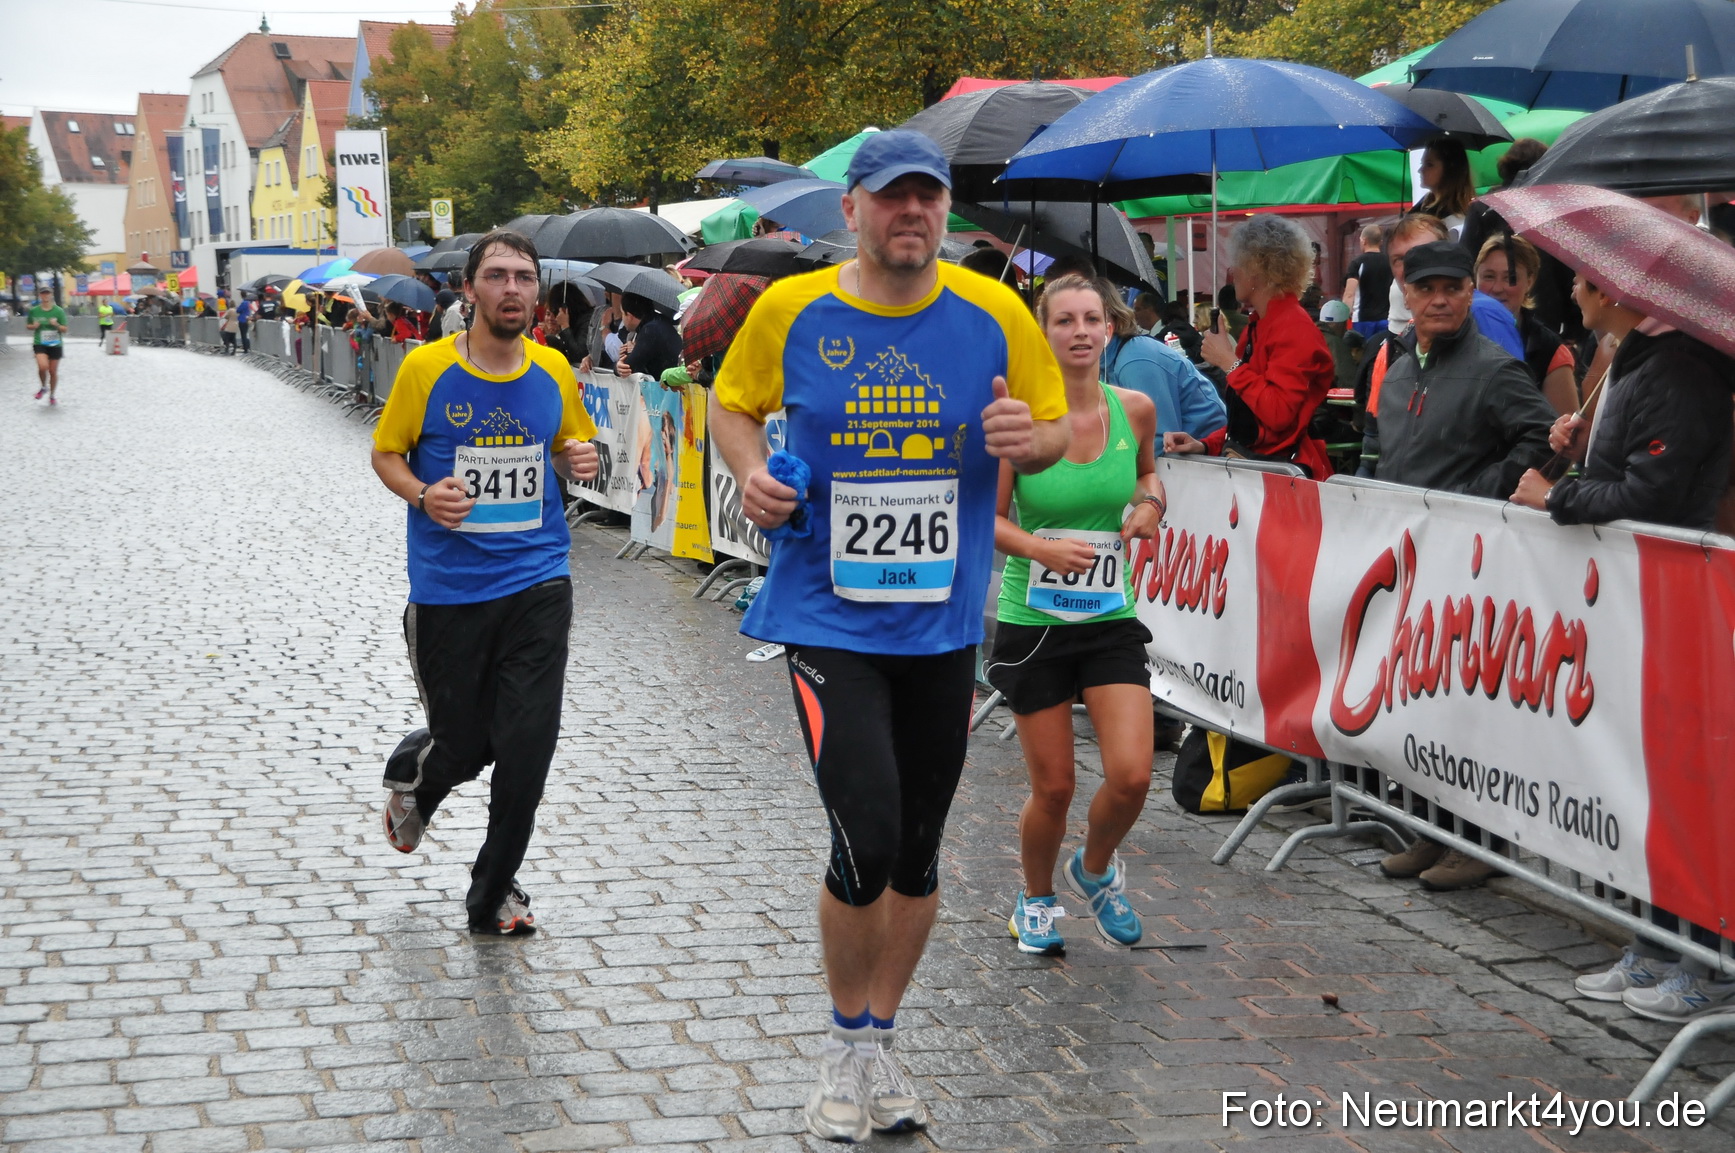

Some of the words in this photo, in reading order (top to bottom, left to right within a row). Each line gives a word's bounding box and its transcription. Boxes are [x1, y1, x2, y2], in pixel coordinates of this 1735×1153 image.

[826, 349, 848, 357] Jahre
[847, 420, 914, 430] 21.September
[916, 420, 940, 429] 2014
[458, 453, 489, 465] PARTL
[491, 455, 534, 465] Neumarkt
[832, 467, 957, 478] www.stadtlauf-neumarkt.de
[464, 466, 538, 500] 3413
[834, 493, 877, 507] PARTL
[880, 494, 940, 507] Neumarkt
[845, 510, 949, 556] 2246
[1086, 541, 1111, 550] markt
[1129, 480, 1239, 620] rivari
[878, 568, 917, 585] Jack
[1053, 594, 1101, 610] Carmen
[1330, 528, 1600, 736] Charivari
[1193, 662, 1245, 709] Radio
[1403, 733, 1540, 817] Ostbayerns
[1548, 780, 1621, 851] Radio
